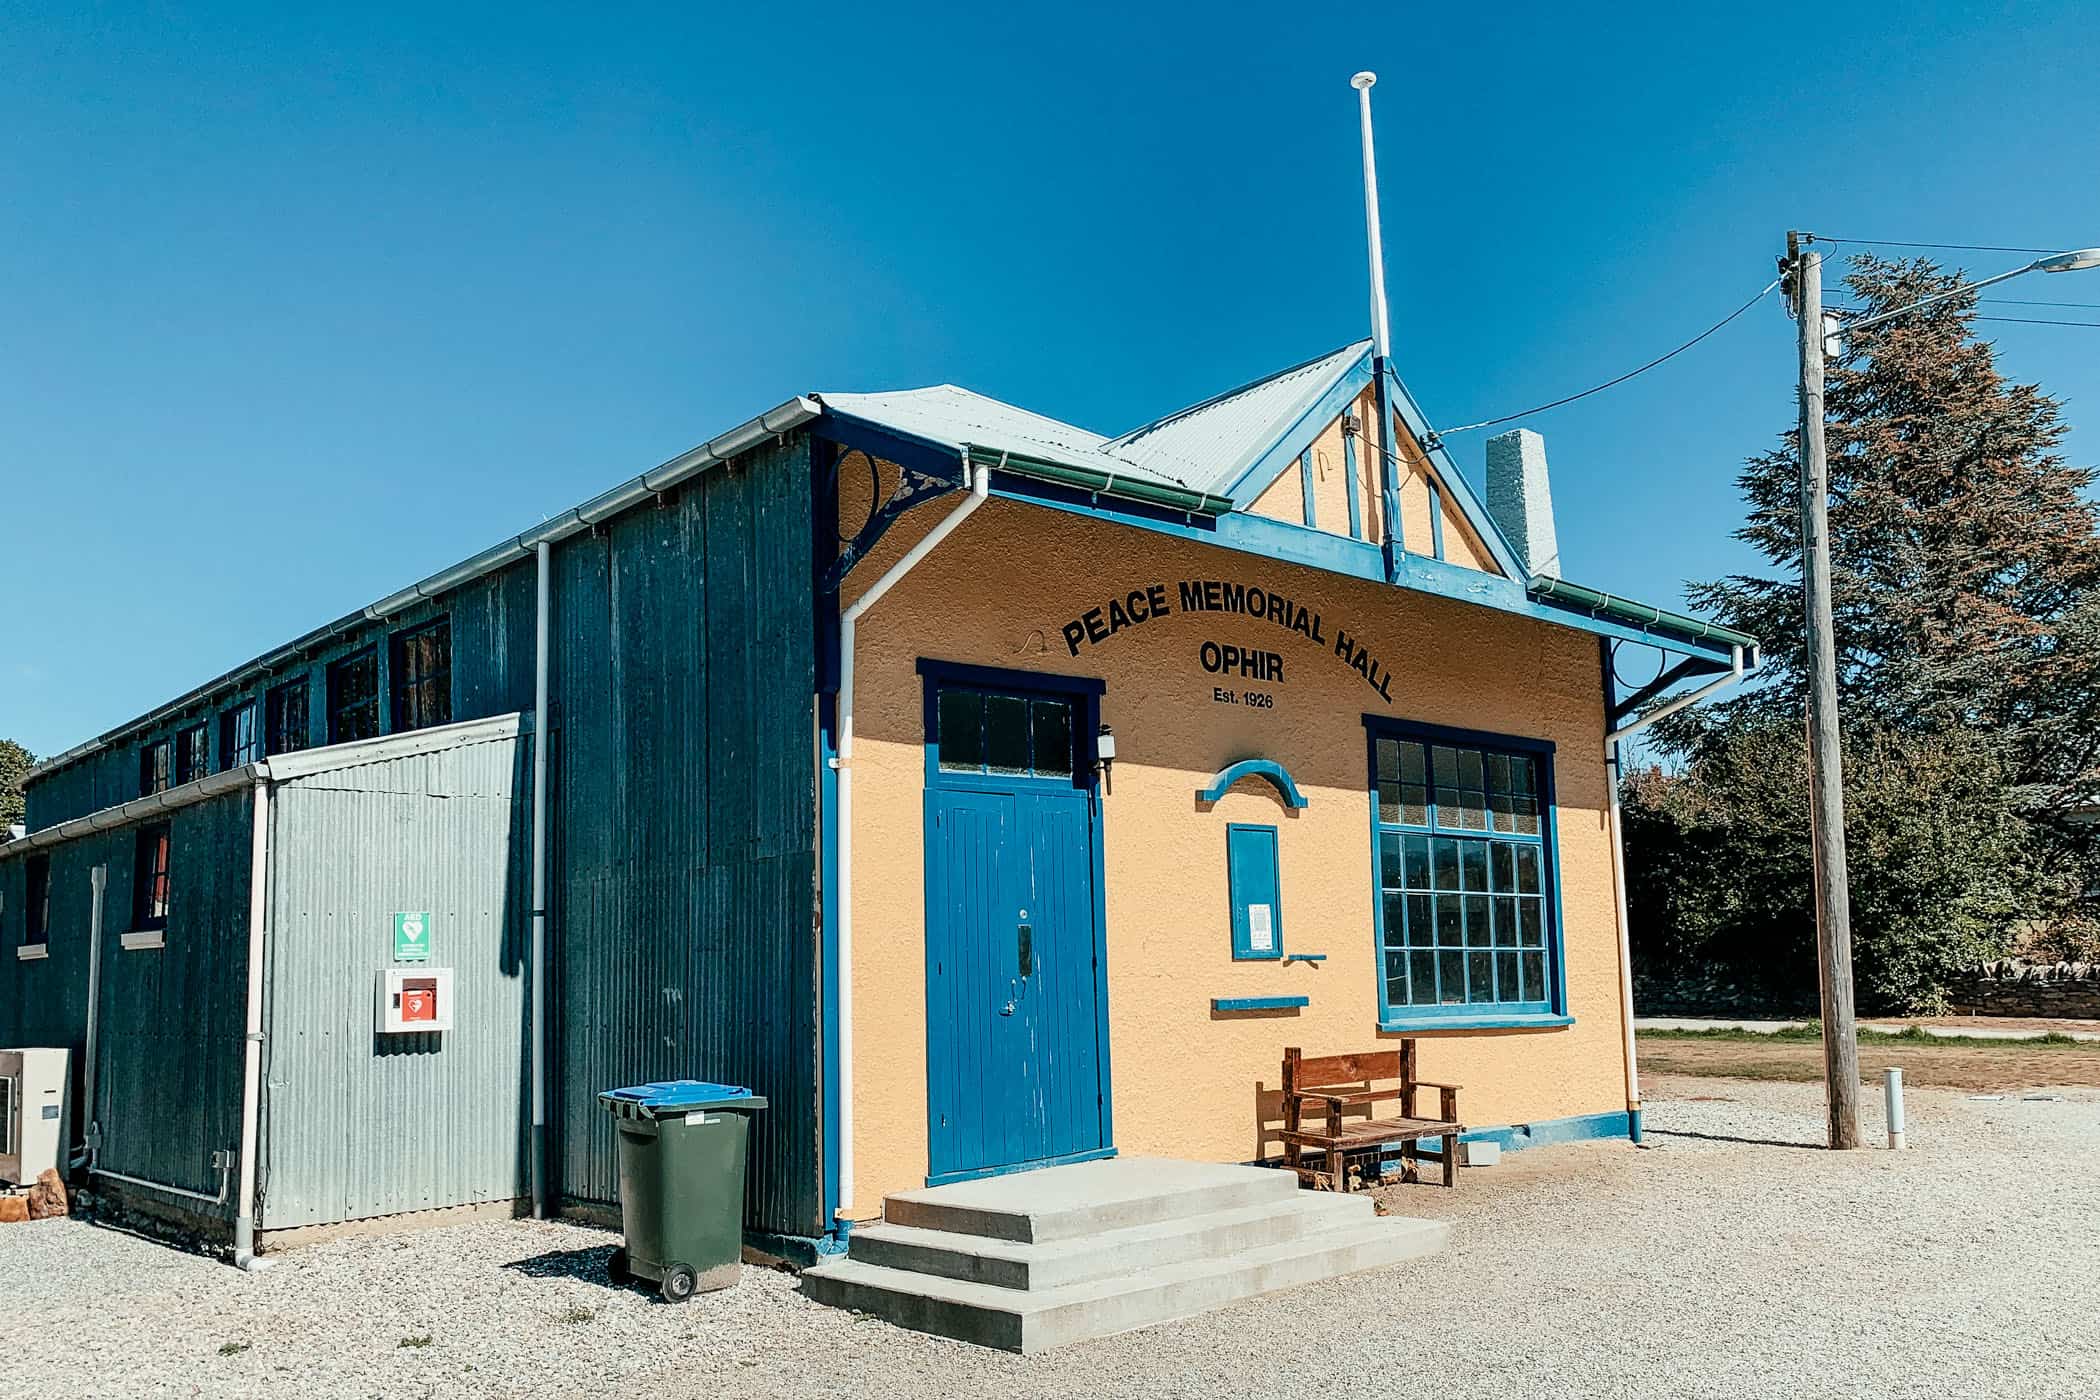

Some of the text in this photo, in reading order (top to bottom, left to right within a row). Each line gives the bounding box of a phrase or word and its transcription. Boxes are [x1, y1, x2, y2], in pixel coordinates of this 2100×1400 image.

[1062, 580, 1393, 705] PEACE MEMORIAL HALL
[1200, 641, 1284, 683] OPHIR
[1213, 687, 1274, 709] Est. 1926
